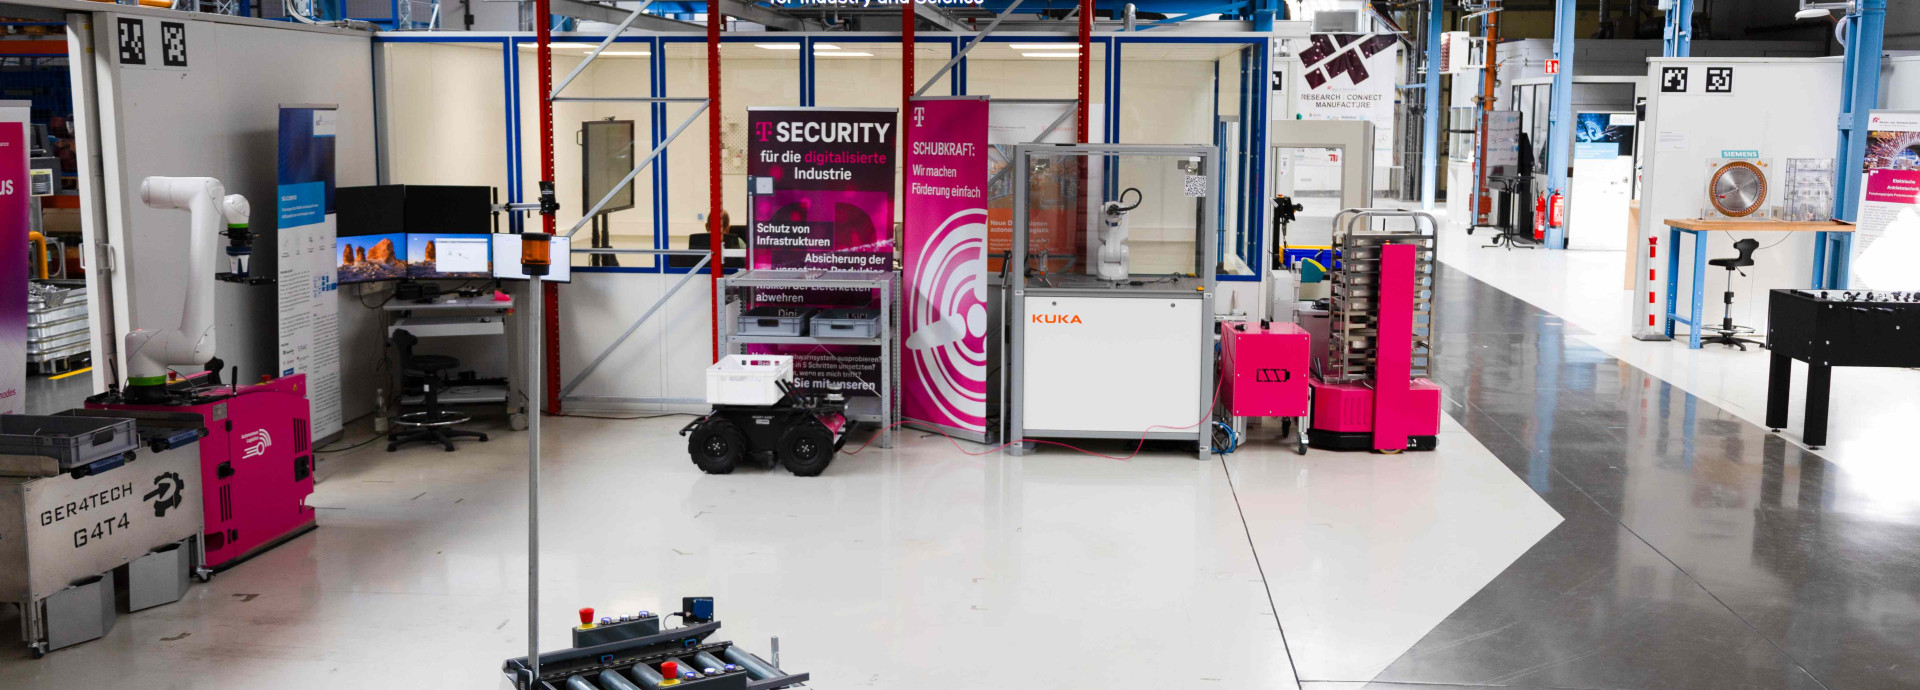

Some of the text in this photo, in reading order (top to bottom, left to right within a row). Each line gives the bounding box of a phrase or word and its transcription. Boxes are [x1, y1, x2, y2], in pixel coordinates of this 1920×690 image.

[776, 121, 891, 143] SECURITY
[912, 141, 976, 157] SCHUBKRAFT:
[760, 150, 887, 166] für die digitalisierte
[794, 167, 852, 180] Industrie
[912, 164, 957, 178] Wir machen
[911, 182, 981, 199] Förderung einfach
[756, 223, 810, 234] Schutz von
[756, 236, 831, 247] Infrastrukturen
[804, 253, 886, 266] Absicherung der
[756, 293, 804, 303] abwehren
[1032, 314, 1082, 324] KUKA
[794, 377, 809, 389] Sie
[41, 482, 133, 526] GER4TECH
[74, 512, 130, 548] G4T4
